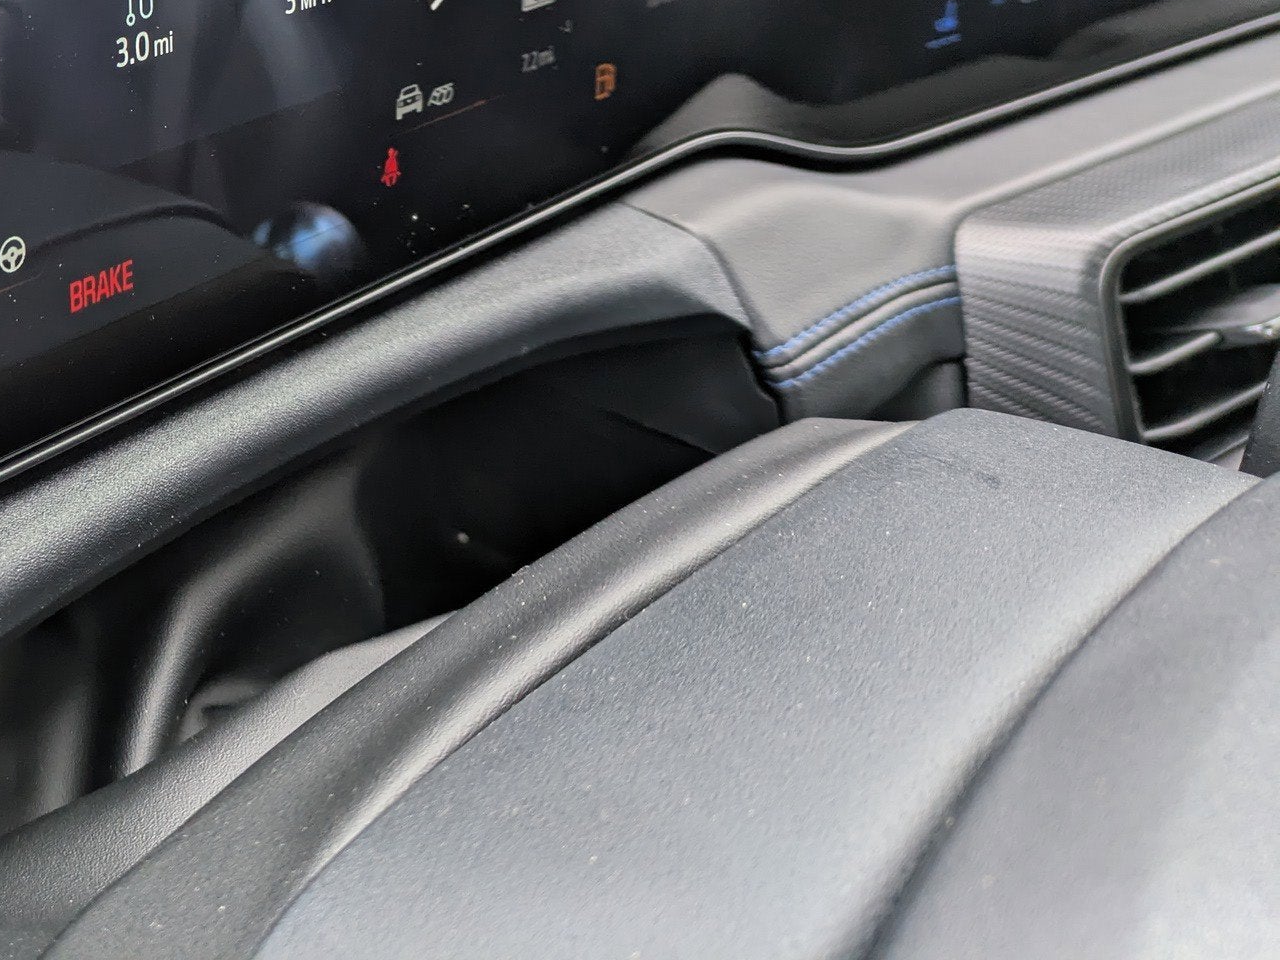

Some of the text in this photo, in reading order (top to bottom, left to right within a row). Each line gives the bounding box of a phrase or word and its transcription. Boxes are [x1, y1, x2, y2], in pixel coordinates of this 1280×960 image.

[116, 30, 173, 69] 3.0 mi
[70, 259, 133, 313] BRAKE
